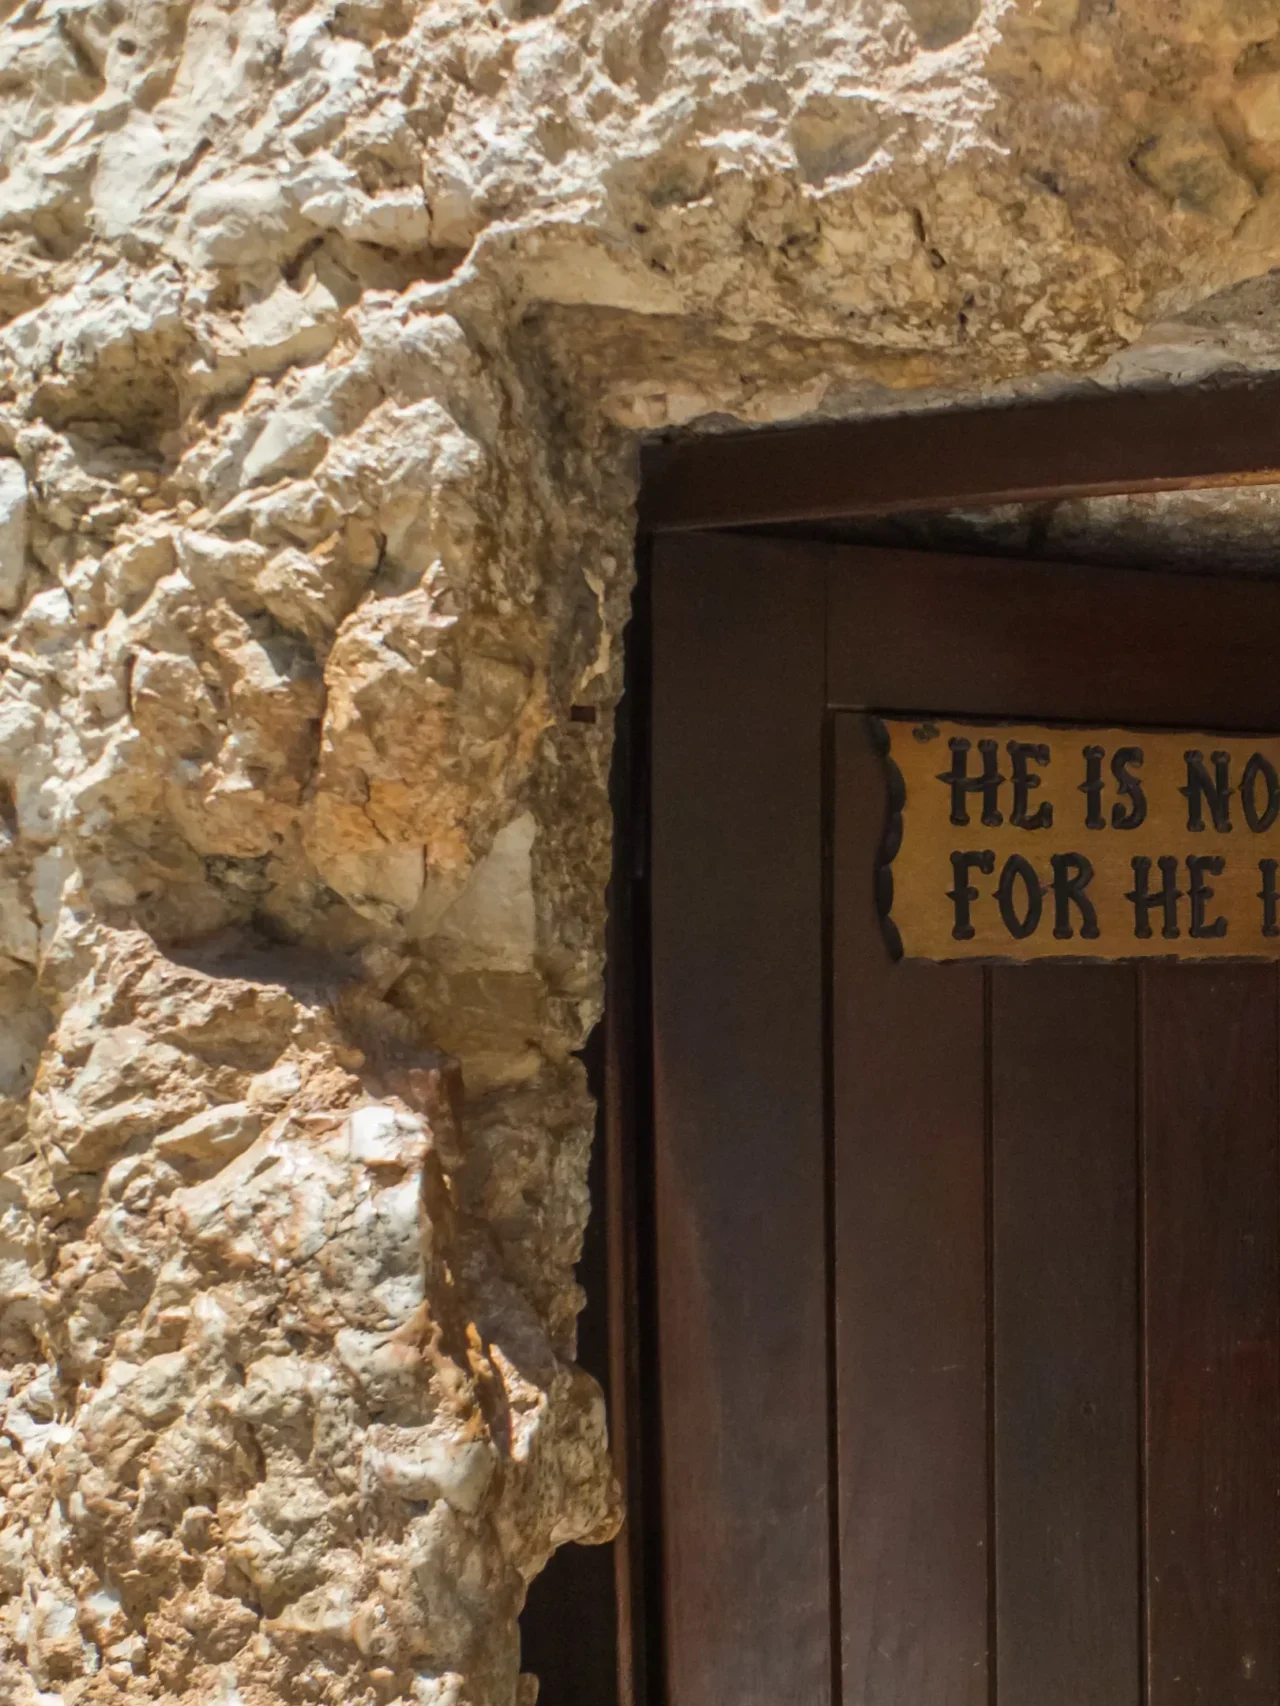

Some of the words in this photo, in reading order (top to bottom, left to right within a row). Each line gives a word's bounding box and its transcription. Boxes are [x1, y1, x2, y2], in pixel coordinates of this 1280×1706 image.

[1077, 745, 1147, 831] IS
[946, 849, 1100, 940] FOR
[1125, 854, 1228, 940] HE
